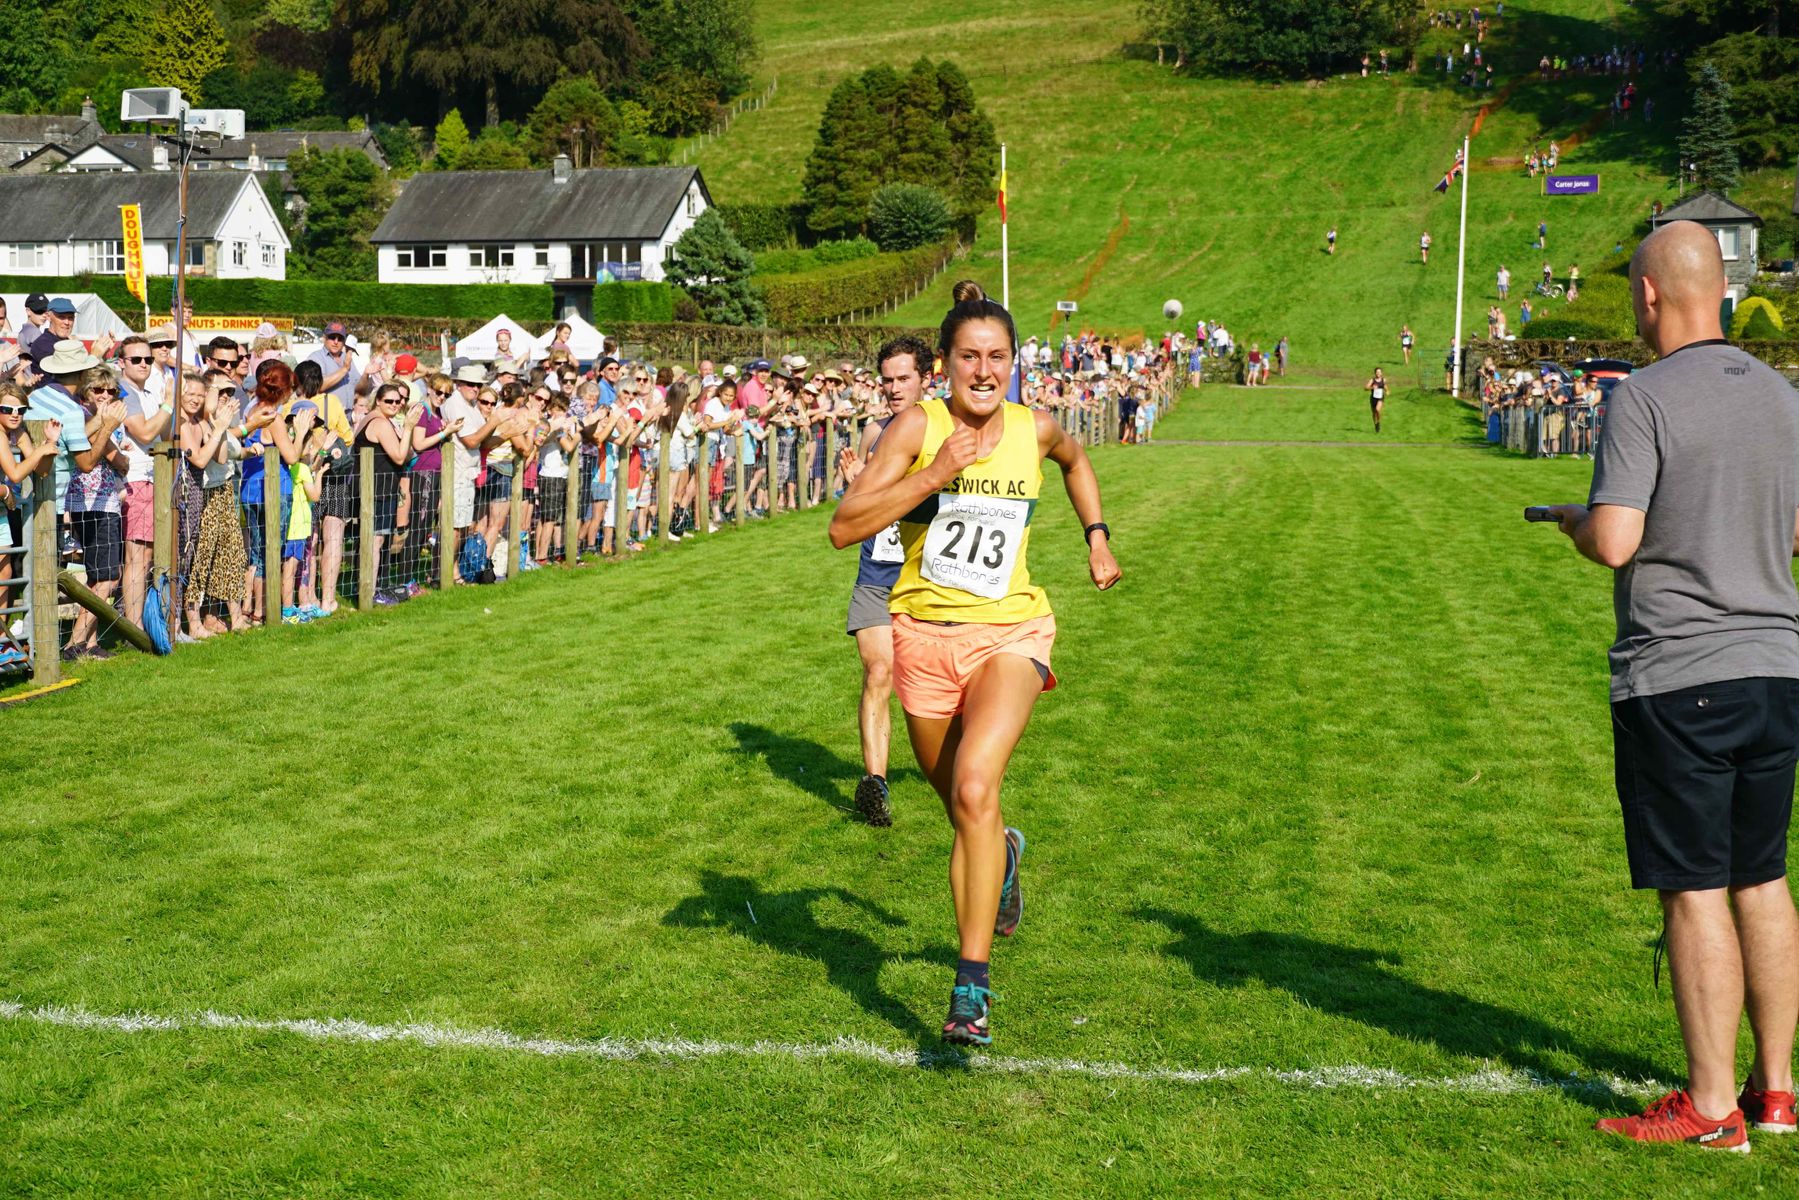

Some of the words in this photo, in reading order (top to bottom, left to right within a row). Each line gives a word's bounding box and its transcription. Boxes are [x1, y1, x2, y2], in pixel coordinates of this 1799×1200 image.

[125, 210, 142, 299] DOUGHNUTS
[222, 319, 260, 329] DRINKS
[1007, 480, 1026, 496] AC
[951, 501, 1017, 520] Rathbones
[939, 520, 1006, 569] 213
[931, 557, 1001, 585] Rathbones
